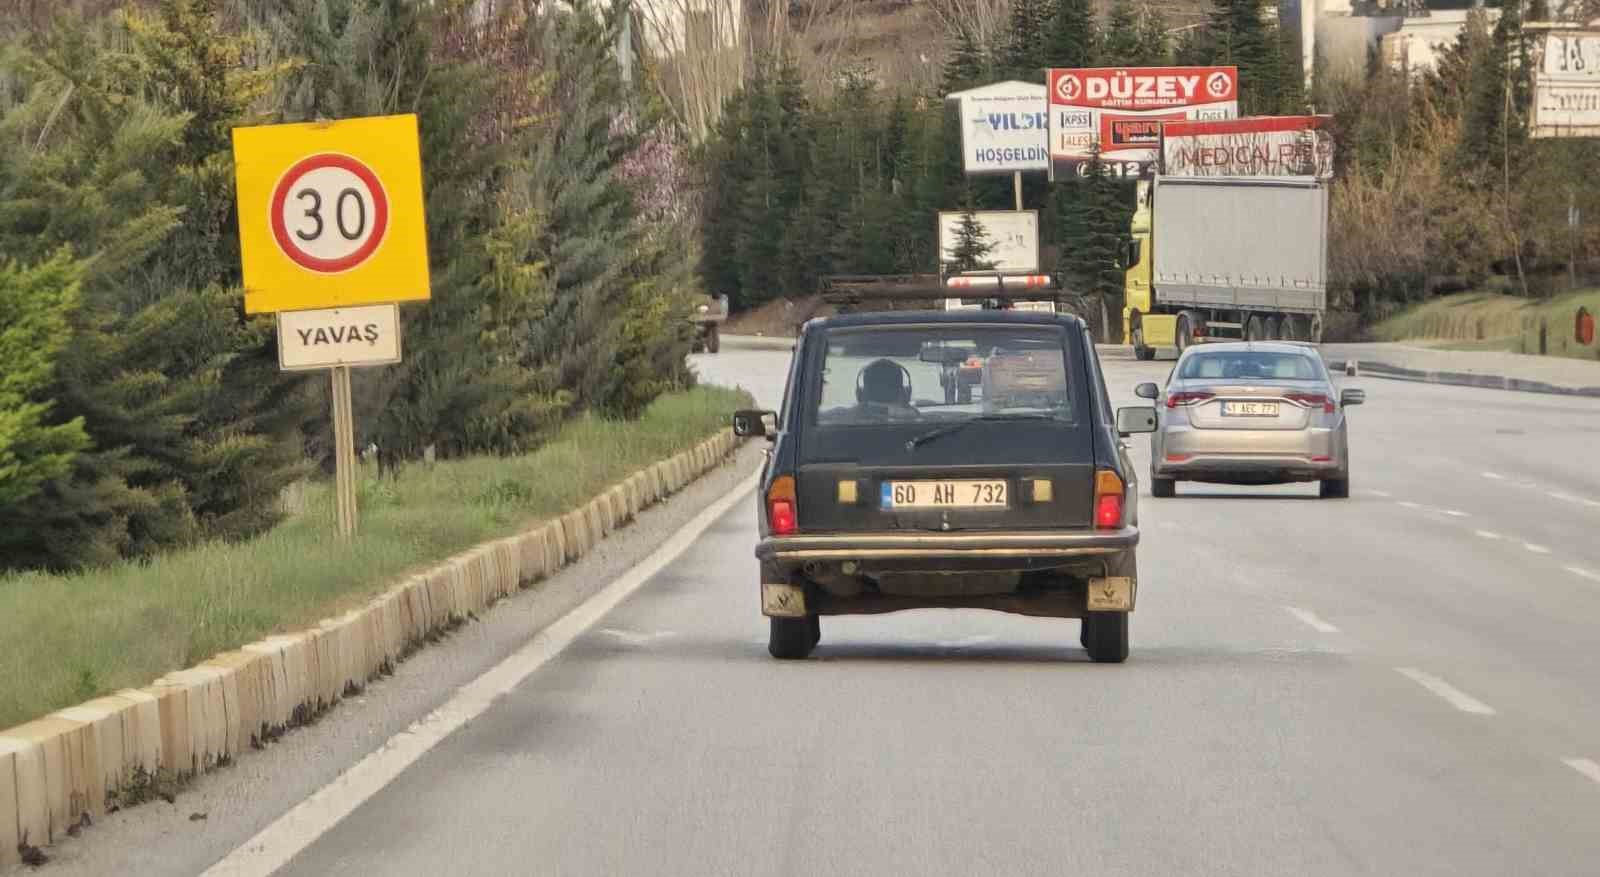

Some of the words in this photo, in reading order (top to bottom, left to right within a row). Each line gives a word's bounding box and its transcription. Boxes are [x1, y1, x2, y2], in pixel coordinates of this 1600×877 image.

[1086, 71, 1200, 99] DÜZEY
[1065, 112, 1088, 124] KPSS
[296, 187, 365, 241] 30
[297, 323, 379, 347] YAVAŞ
[895, 484, 916, 504] 60
[933, 484, 955, 504] AH
[972, 484, 1005, 503] 732
